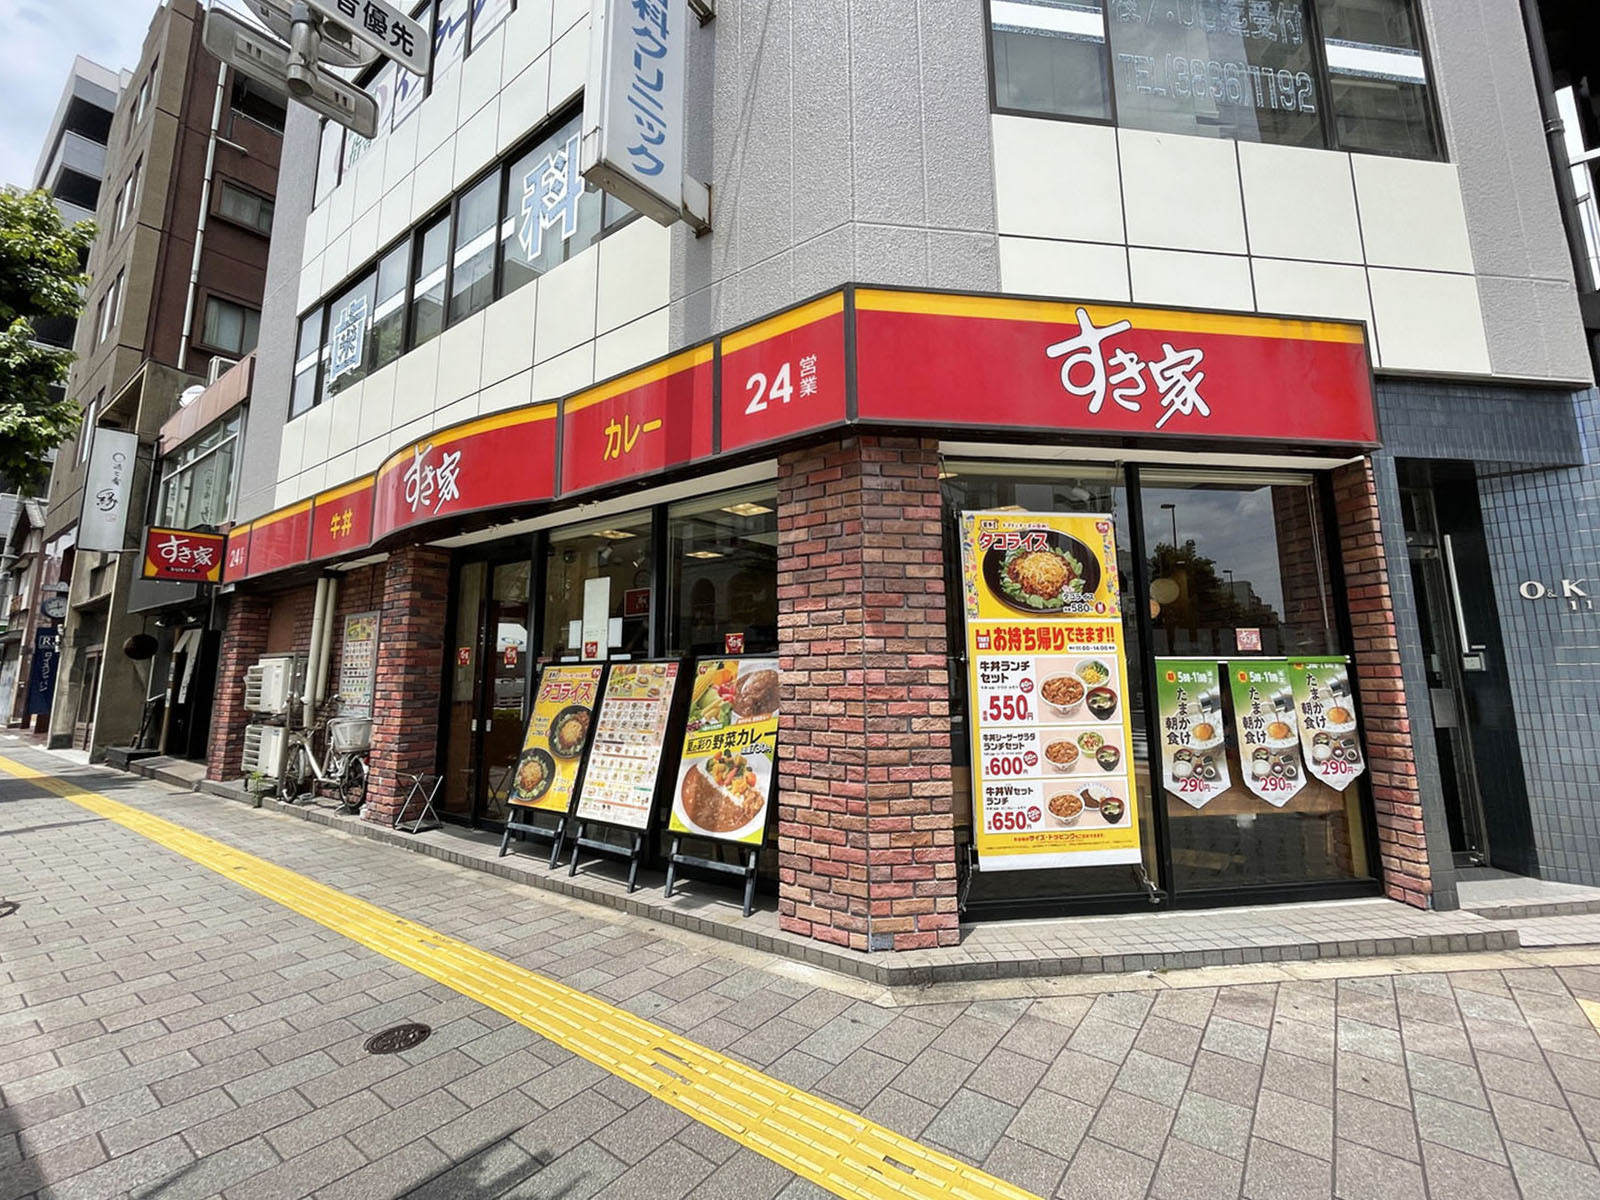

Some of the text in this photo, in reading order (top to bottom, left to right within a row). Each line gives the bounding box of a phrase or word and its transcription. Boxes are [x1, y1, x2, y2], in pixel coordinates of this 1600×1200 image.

[518, 133, 585, 262] 科
[1046, 307, 1211, 430] すき家
[745, 353, 818, 415] 24 営業
[604, 414, 663, 461] カレー
[403, 443, 461, 514] すき家
[330, 508, 353, 540] 牛丼
[157, 535, 213, 568] すき家
[979, 532, 1050, 551] タコライス
[980, 660, 1030, 672] 牛丼ランチ
[980, 672, 1009, 683] セット
[541, 682, 593, 702] タコライス
[1306, 673, 1326, 728] たまかけ
[1177, 688, 1191, 745] たまかけ
[1242, 716, 1256, 744] 朝食
[1249, 687, 1266, 744] たまかけ
[1301, 702, 1316, 729] 朝食
[1165, 717, 1180, 745] 朝食
[983, 742, 1025, 751] ランチセット
[986, 786, 1034, 796] 牛丼Wセット
[986, 796, 1009, 806] ランチ
